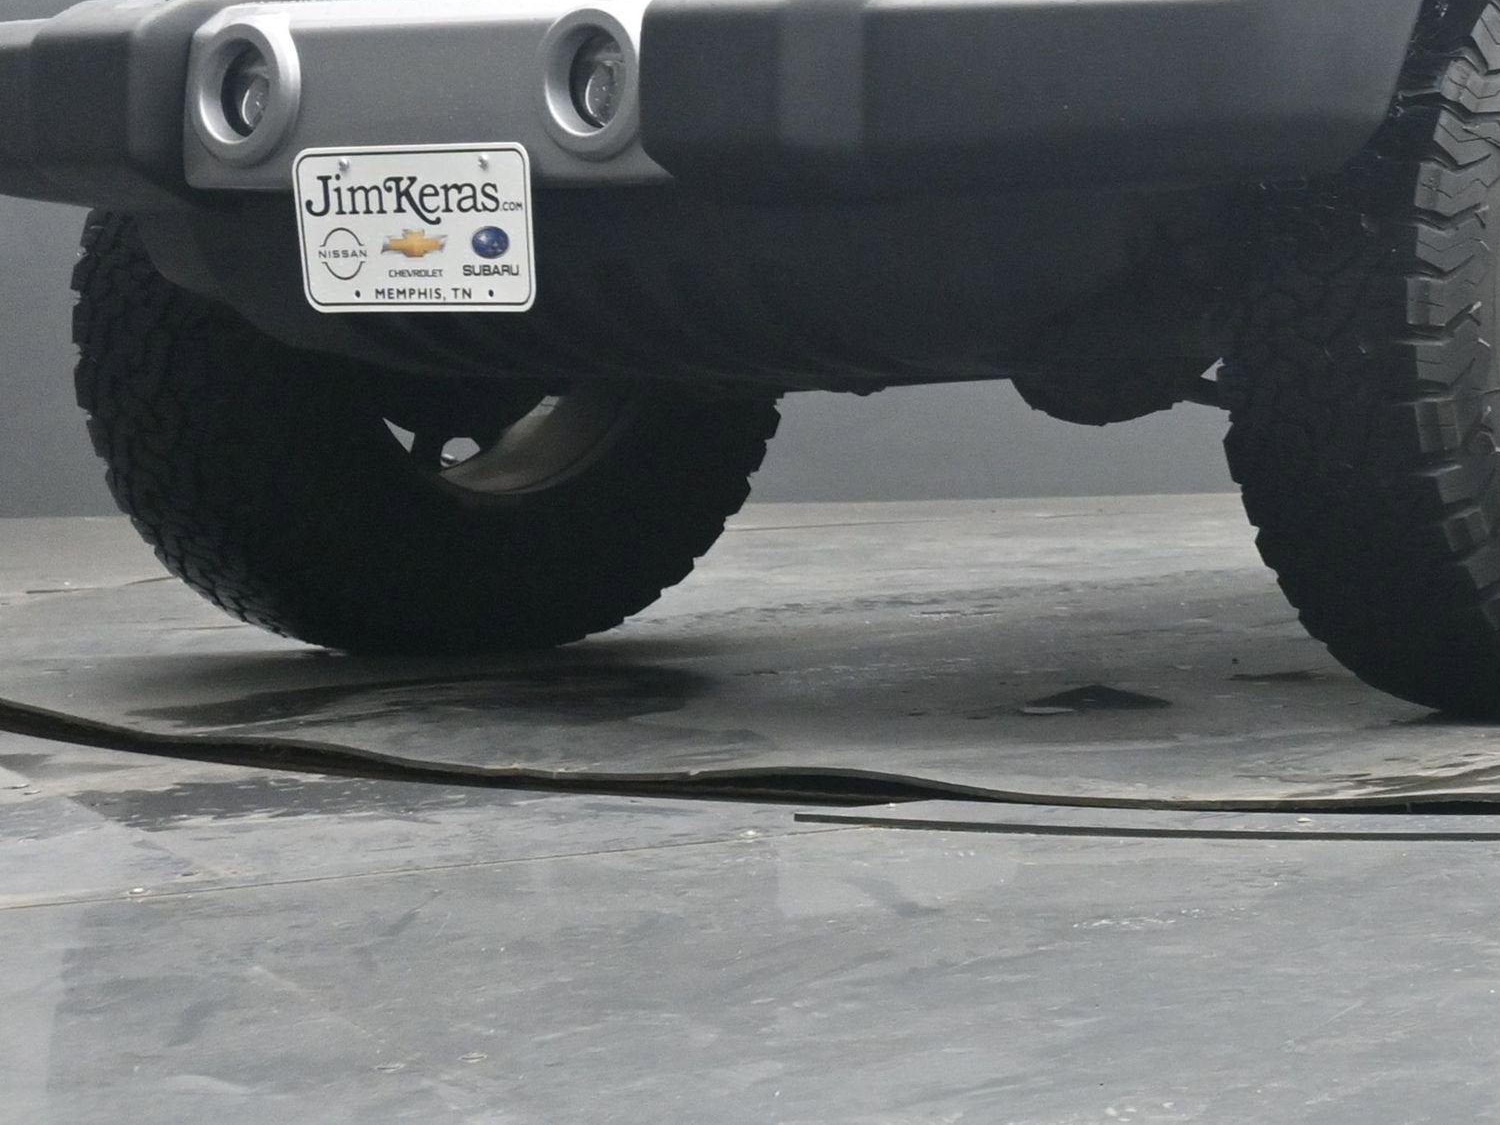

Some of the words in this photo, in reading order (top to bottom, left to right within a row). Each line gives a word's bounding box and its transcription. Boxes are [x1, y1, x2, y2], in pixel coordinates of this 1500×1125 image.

[318, 249, 367, 259] NISSAN
[388, 268, 444, 278] CHEVROLET
[462, 264, 520, 277] SUBARU
[375, 287, 447, 300] MEMPHIS,
[451, 287, 473, 299] TN
